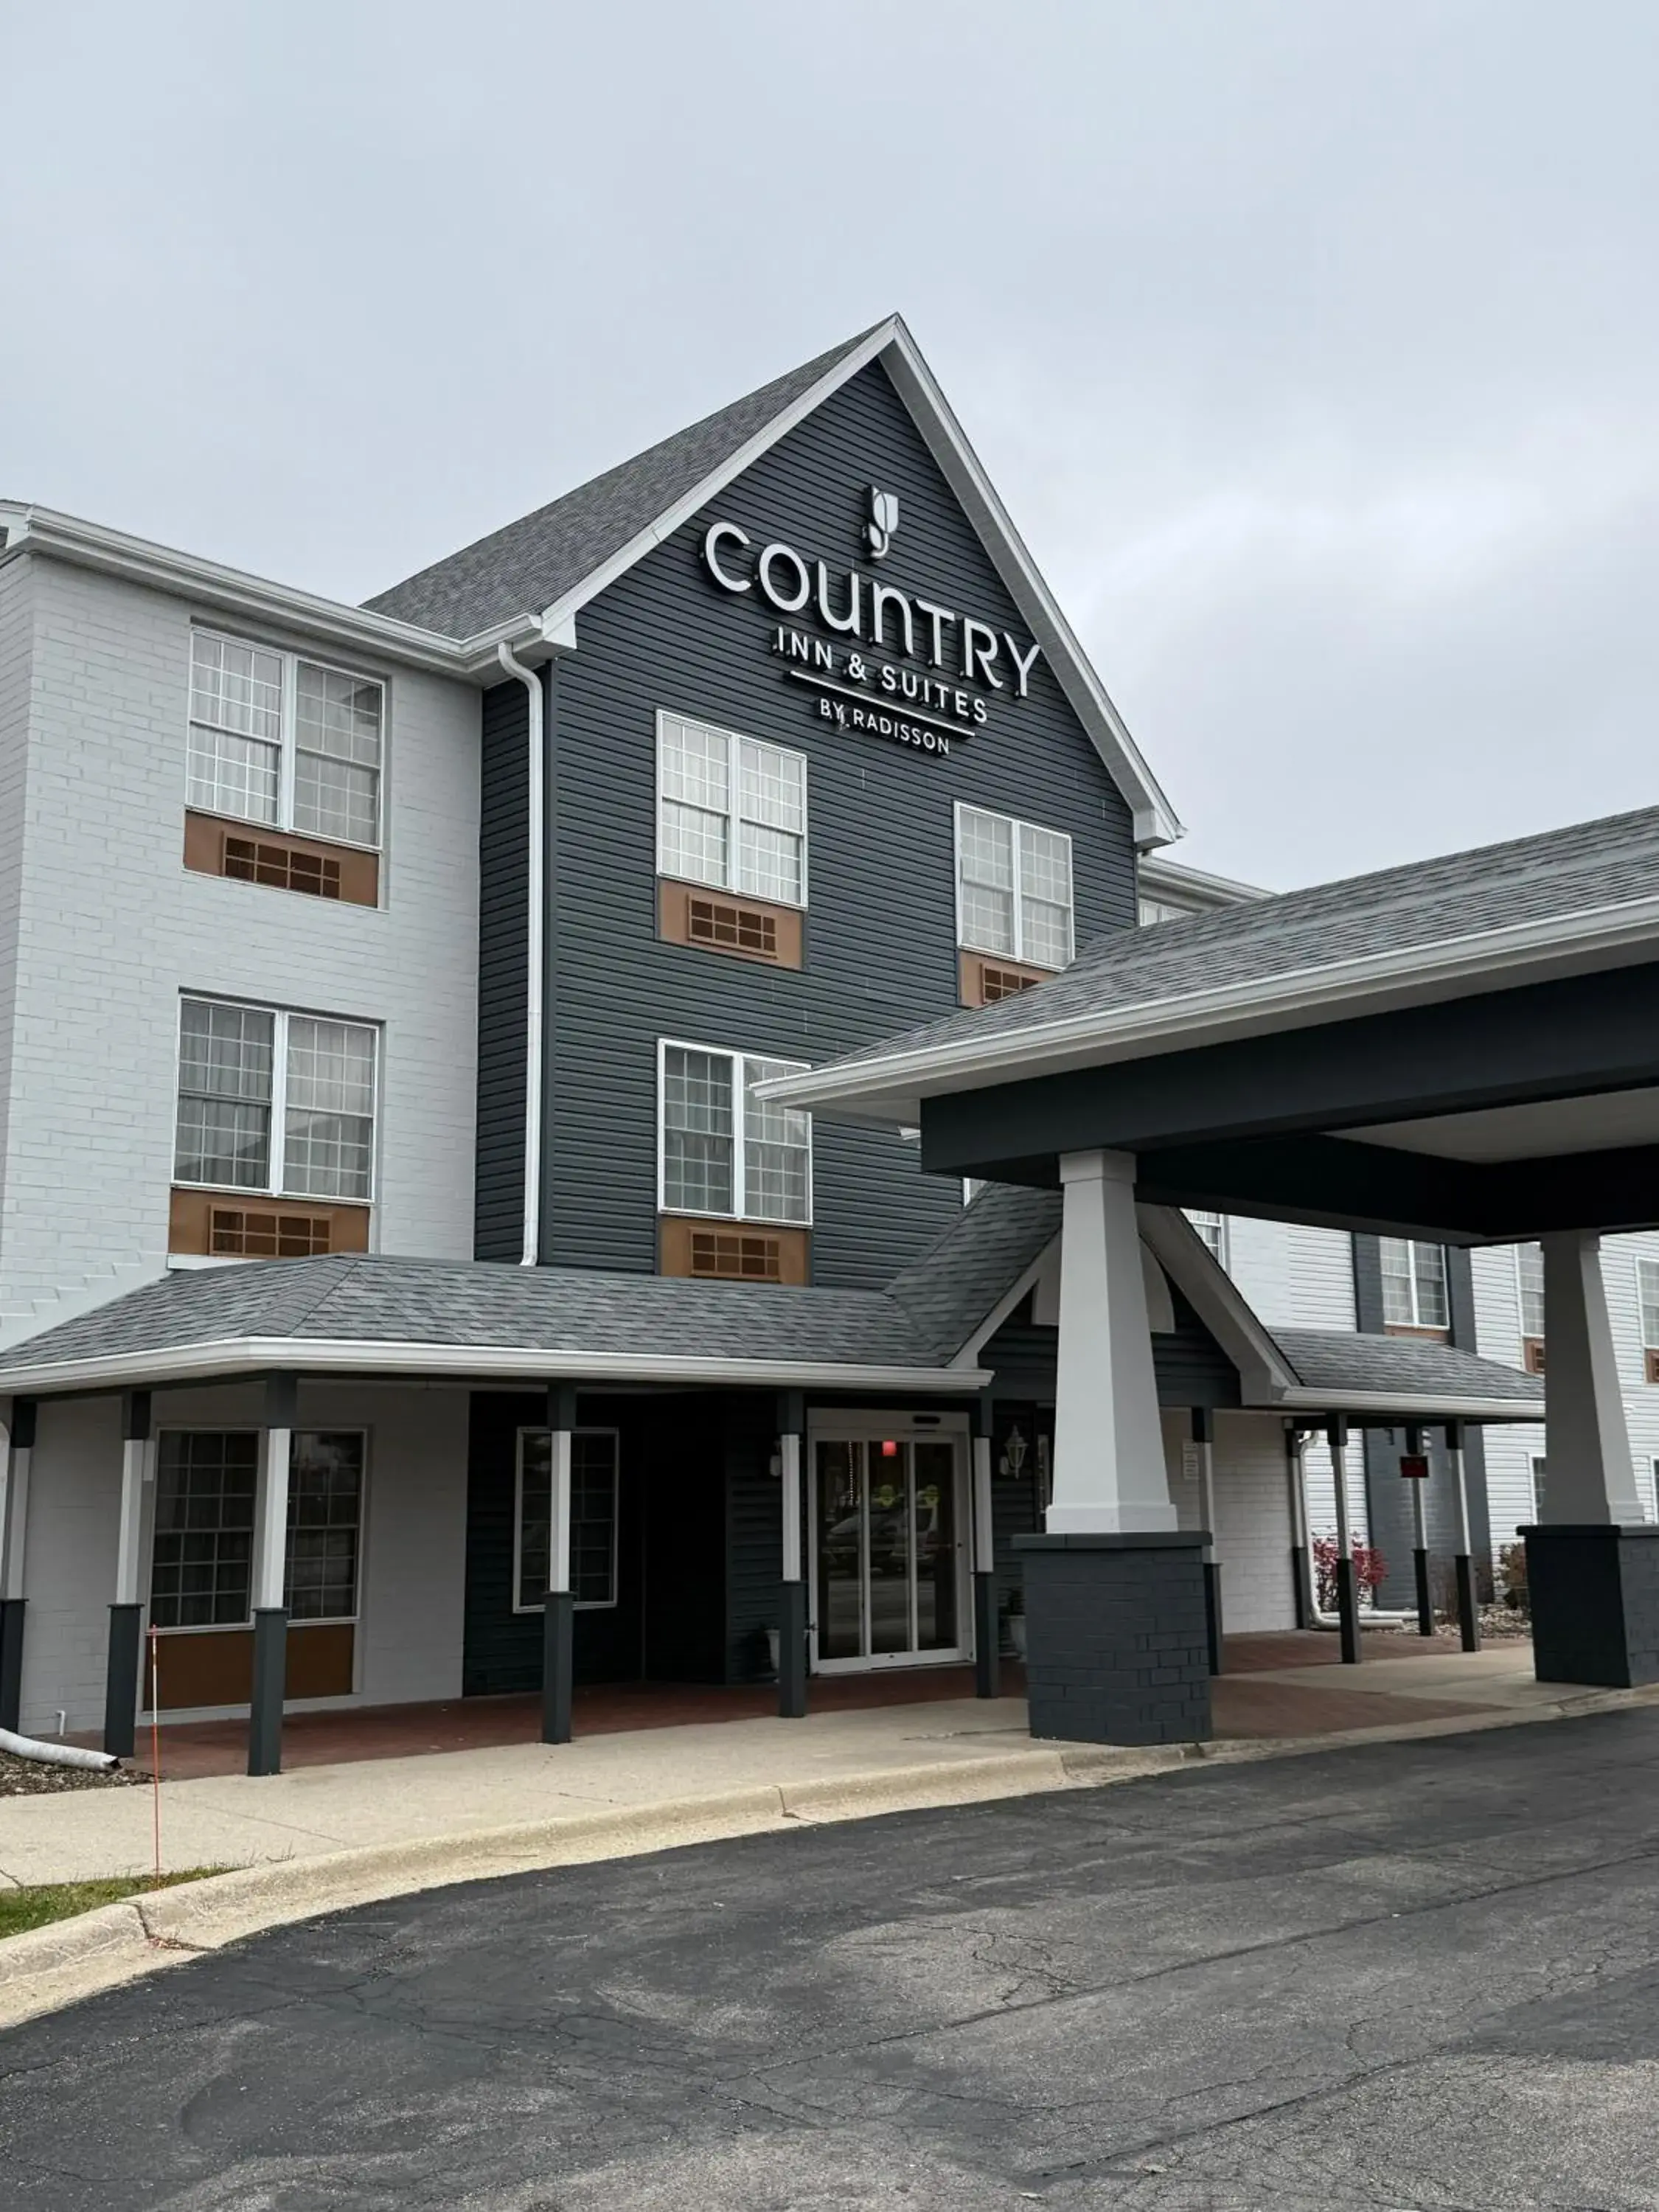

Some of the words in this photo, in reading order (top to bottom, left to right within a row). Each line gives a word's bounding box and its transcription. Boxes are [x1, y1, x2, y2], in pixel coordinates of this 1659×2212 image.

[776, 627, 832, 669] INN
[848, 653, 867, 681] &
[881, 665, 988, 724] SUITES
[819, 698, 844, 720] BY
[852, 707, 950, 755] RADISSON
